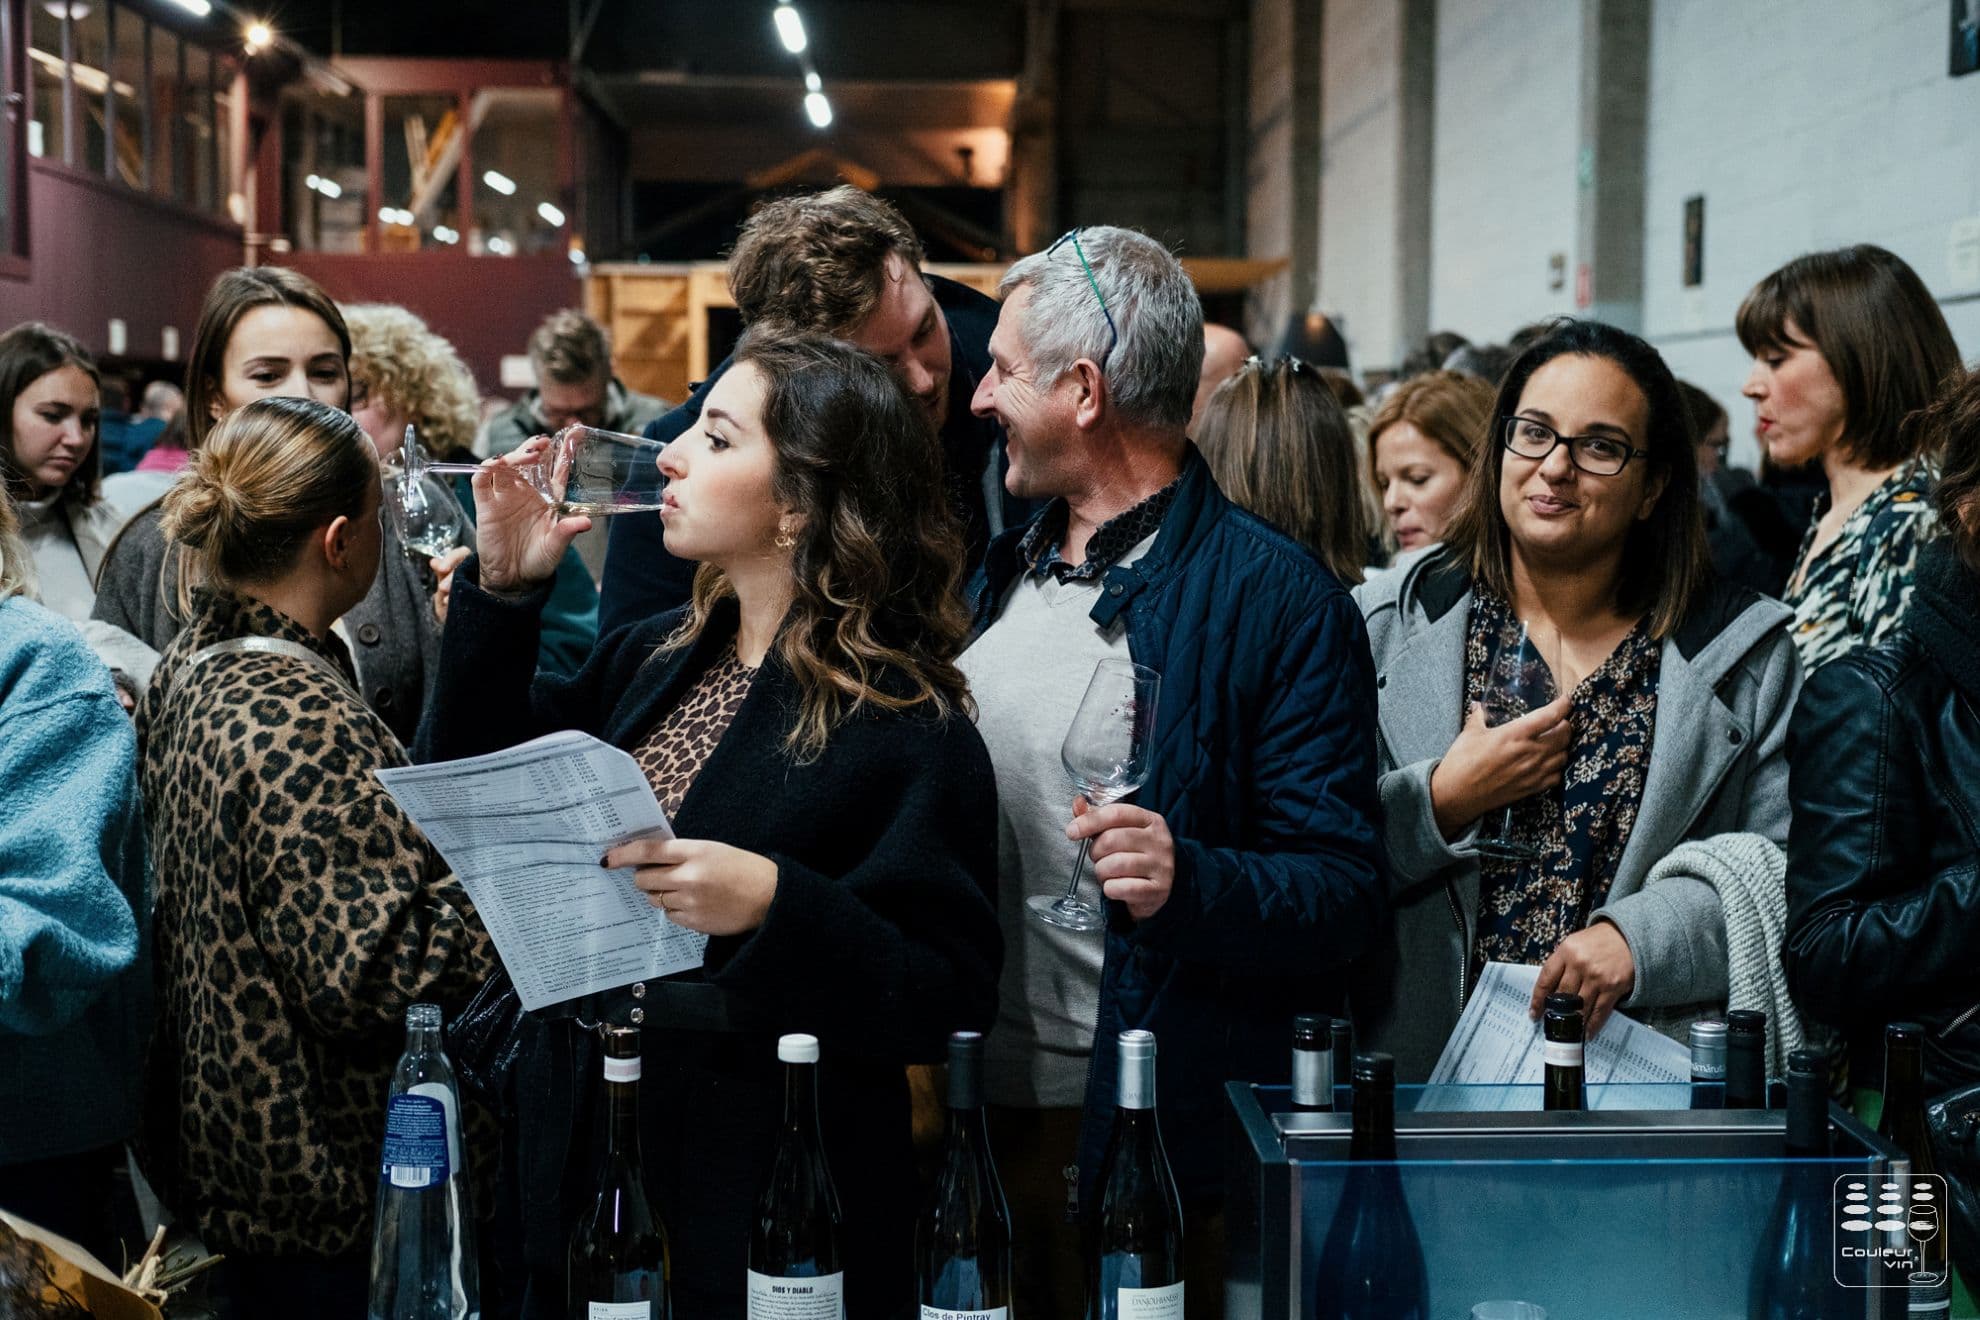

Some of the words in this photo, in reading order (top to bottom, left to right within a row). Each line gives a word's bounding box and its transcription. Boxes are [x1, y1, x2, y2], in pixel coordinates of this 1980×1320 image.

[772, 1286, 785, 1294] DIOS
[792, 1286, 813, 1294] DIABLO
[922, 1307, 940, 1319] Clos
